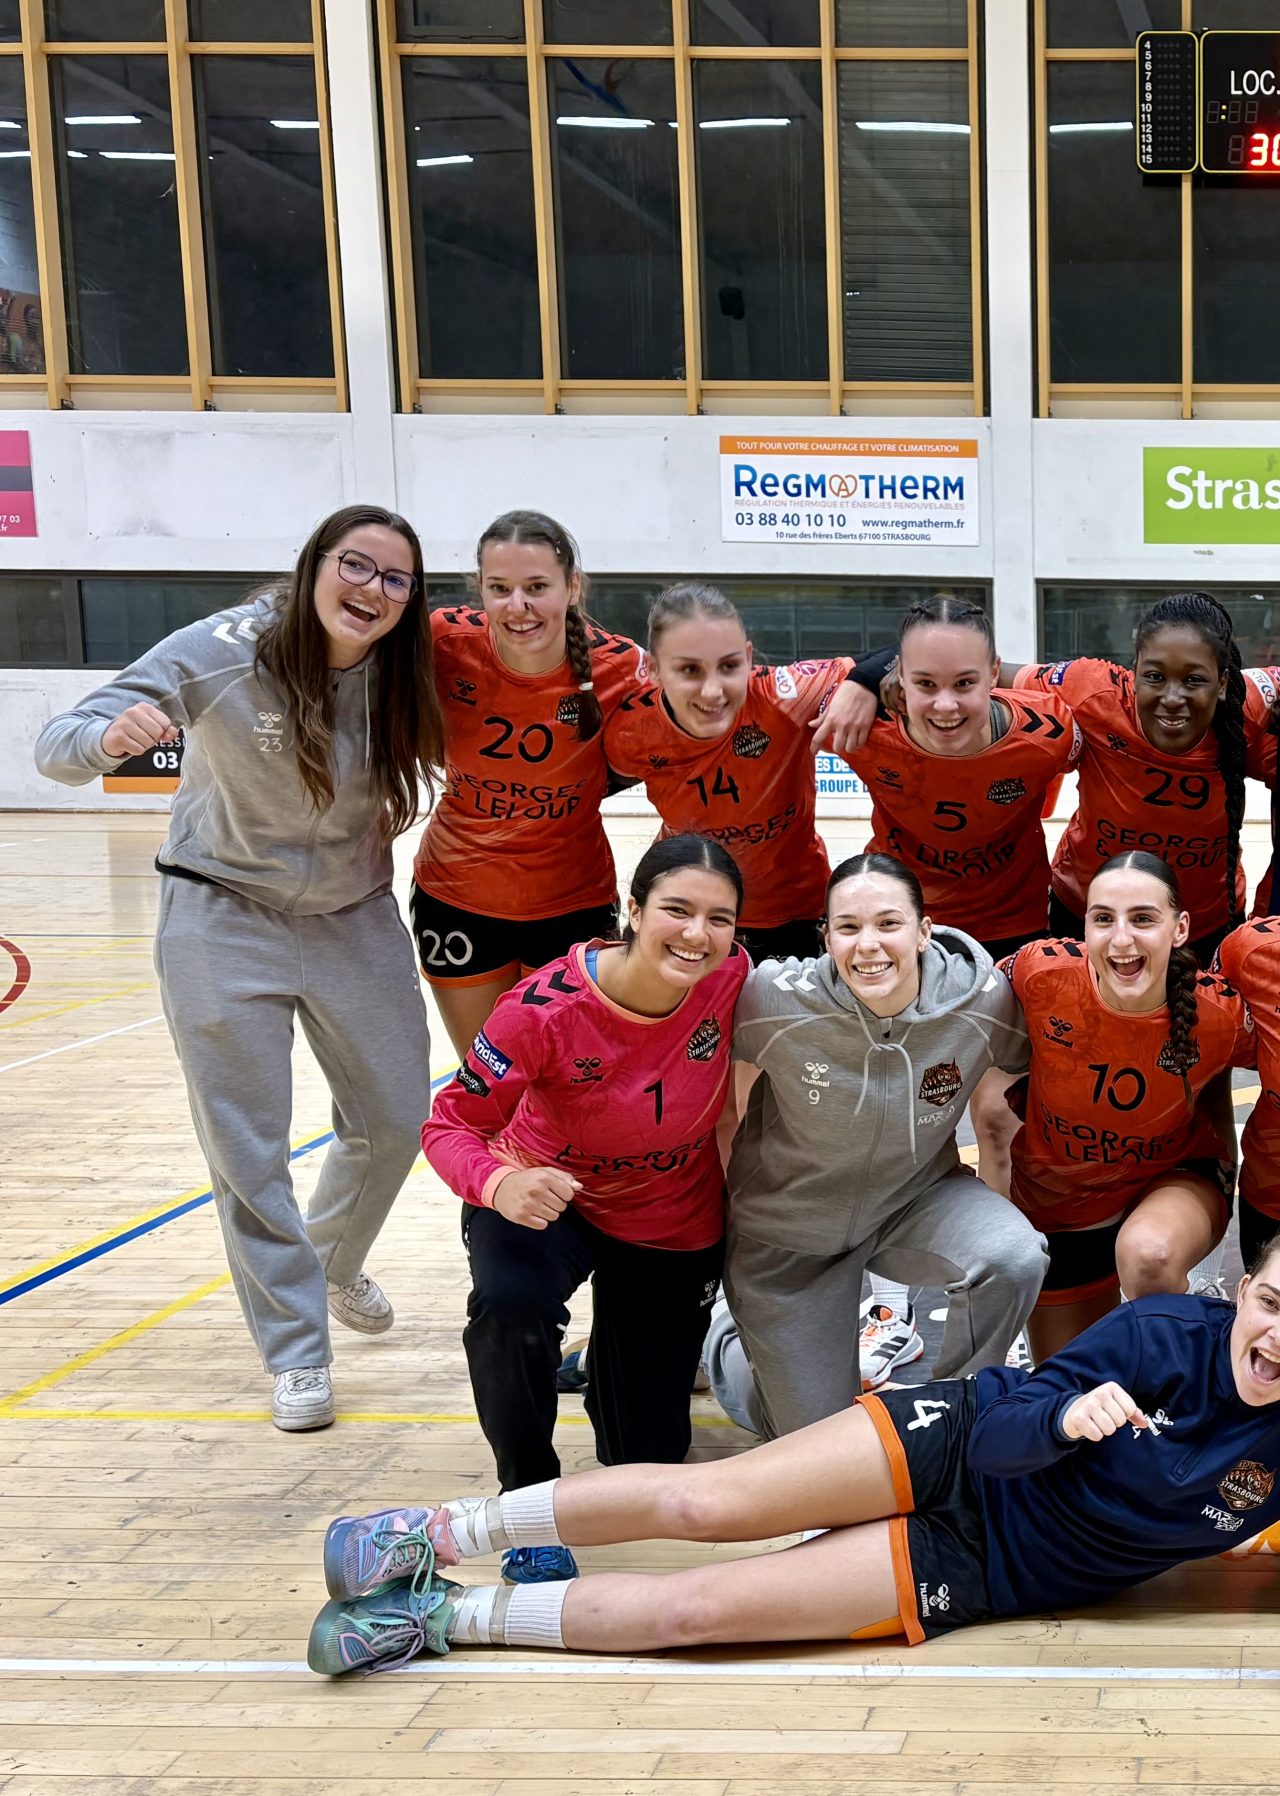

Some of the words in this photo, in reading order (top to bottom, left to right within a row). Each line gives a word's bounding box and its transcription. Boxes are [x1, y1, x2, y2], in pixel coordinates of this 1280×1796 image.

[1144, 41, 1151, 49] 4
[1145, 51, 1152, 60] 5
[1145, 61, 1152, 70] 6
[1145, 72, 1152, 80] 7
[1230, 70, 1280, 95] LOC.
[1145, 82, 1152, 91] 8
[1145, 92, 1152, 101] 9
[1141, 103, 1152, 112] 10
[1141, 114, 1150, 122] 11
[1141, 124, 1152, 133] 12
[1141, 134, 1152, 143] 13
[1141, 145, 1152, 153] 14
[1141, 155, 1152, 164] 15
[736, 442, 758, 450] TOUT
[759, 442, 782, 450] POUR
[783, 442, 809, 451] VOTRE
[811, 443, 858, 452] CHAUFFAGE
[859, 444, 869, 452] ET
[871, 444, 897, 452] VOTRE
[898, 444, 960, 453] CLIMATISATION
[789, 500, 838, 508] THERMIQUE
[893, 502, 966, 510] RENOUVELABLES
[9, 515, 20, 523] 03
[735, 512, 754, 526] 03
[758, 513, 777, 526] 88
[781, 514, 800, 526] 40
[806, 514, 823, 527] 10
[829, 514, 846, 527] 10
[862, 518, 965, 529] www.regmatherm.fr
[775, 531, 784, 539] 10
[800, 531, 812, 539] des
[834, 532, 857, 540] Eberts
[882, 533, 931, 541] STRASBOURG
[258, 737, 283, 752] 23
[479, 716, 554, 763] 20
[152, 751, 178, 769] 03
[687, 767, 740, 807] 14
[1142, 768, 1210, 810] 29
[932, 800, 967, 832] 5
[1097, 818, 1229, 850] GEORGE
[423, 930, 473, 966] 20
[801, 1075, 830, 1088] hummel
[1088, 1063, 1147, 1112] 10
[808, 1089, 820, 1105] 9
[921, 1081, 963, 1099] STRASBOURG
[644, 1079, 664, 1126] 1
[907, 1400, 950, 1430] 4
[1220, 1480, 1266, 1504] STRASBOURG
[919, 1582, 931, 1618] hummel
